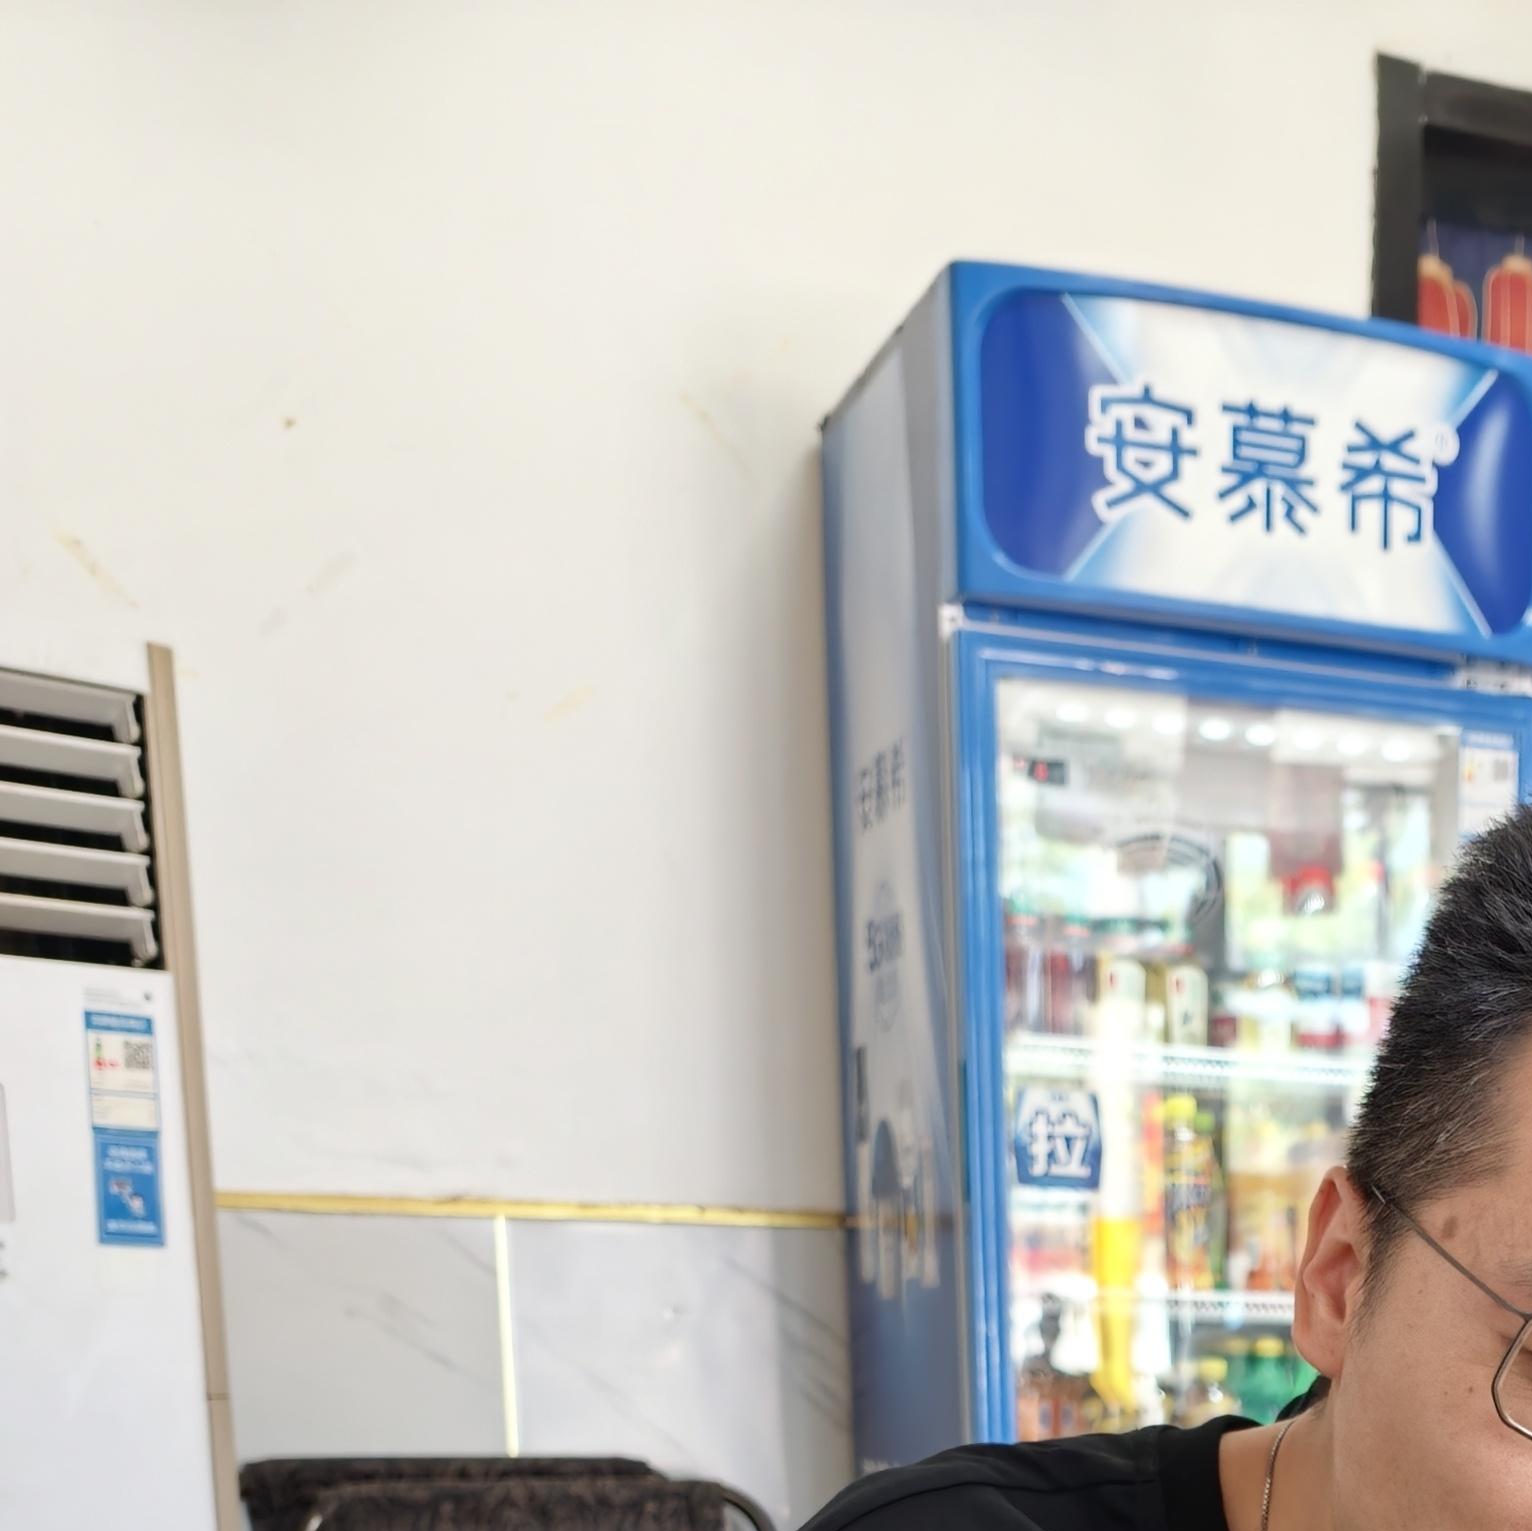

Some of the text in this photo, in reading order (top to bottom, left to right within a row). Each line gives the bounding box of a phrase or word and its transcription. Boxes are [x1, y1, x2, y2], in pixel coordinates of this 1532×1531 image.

[1095, 382, 1427, 552] 安慕希
[1026, 1110, 1093, 1179] 拉
